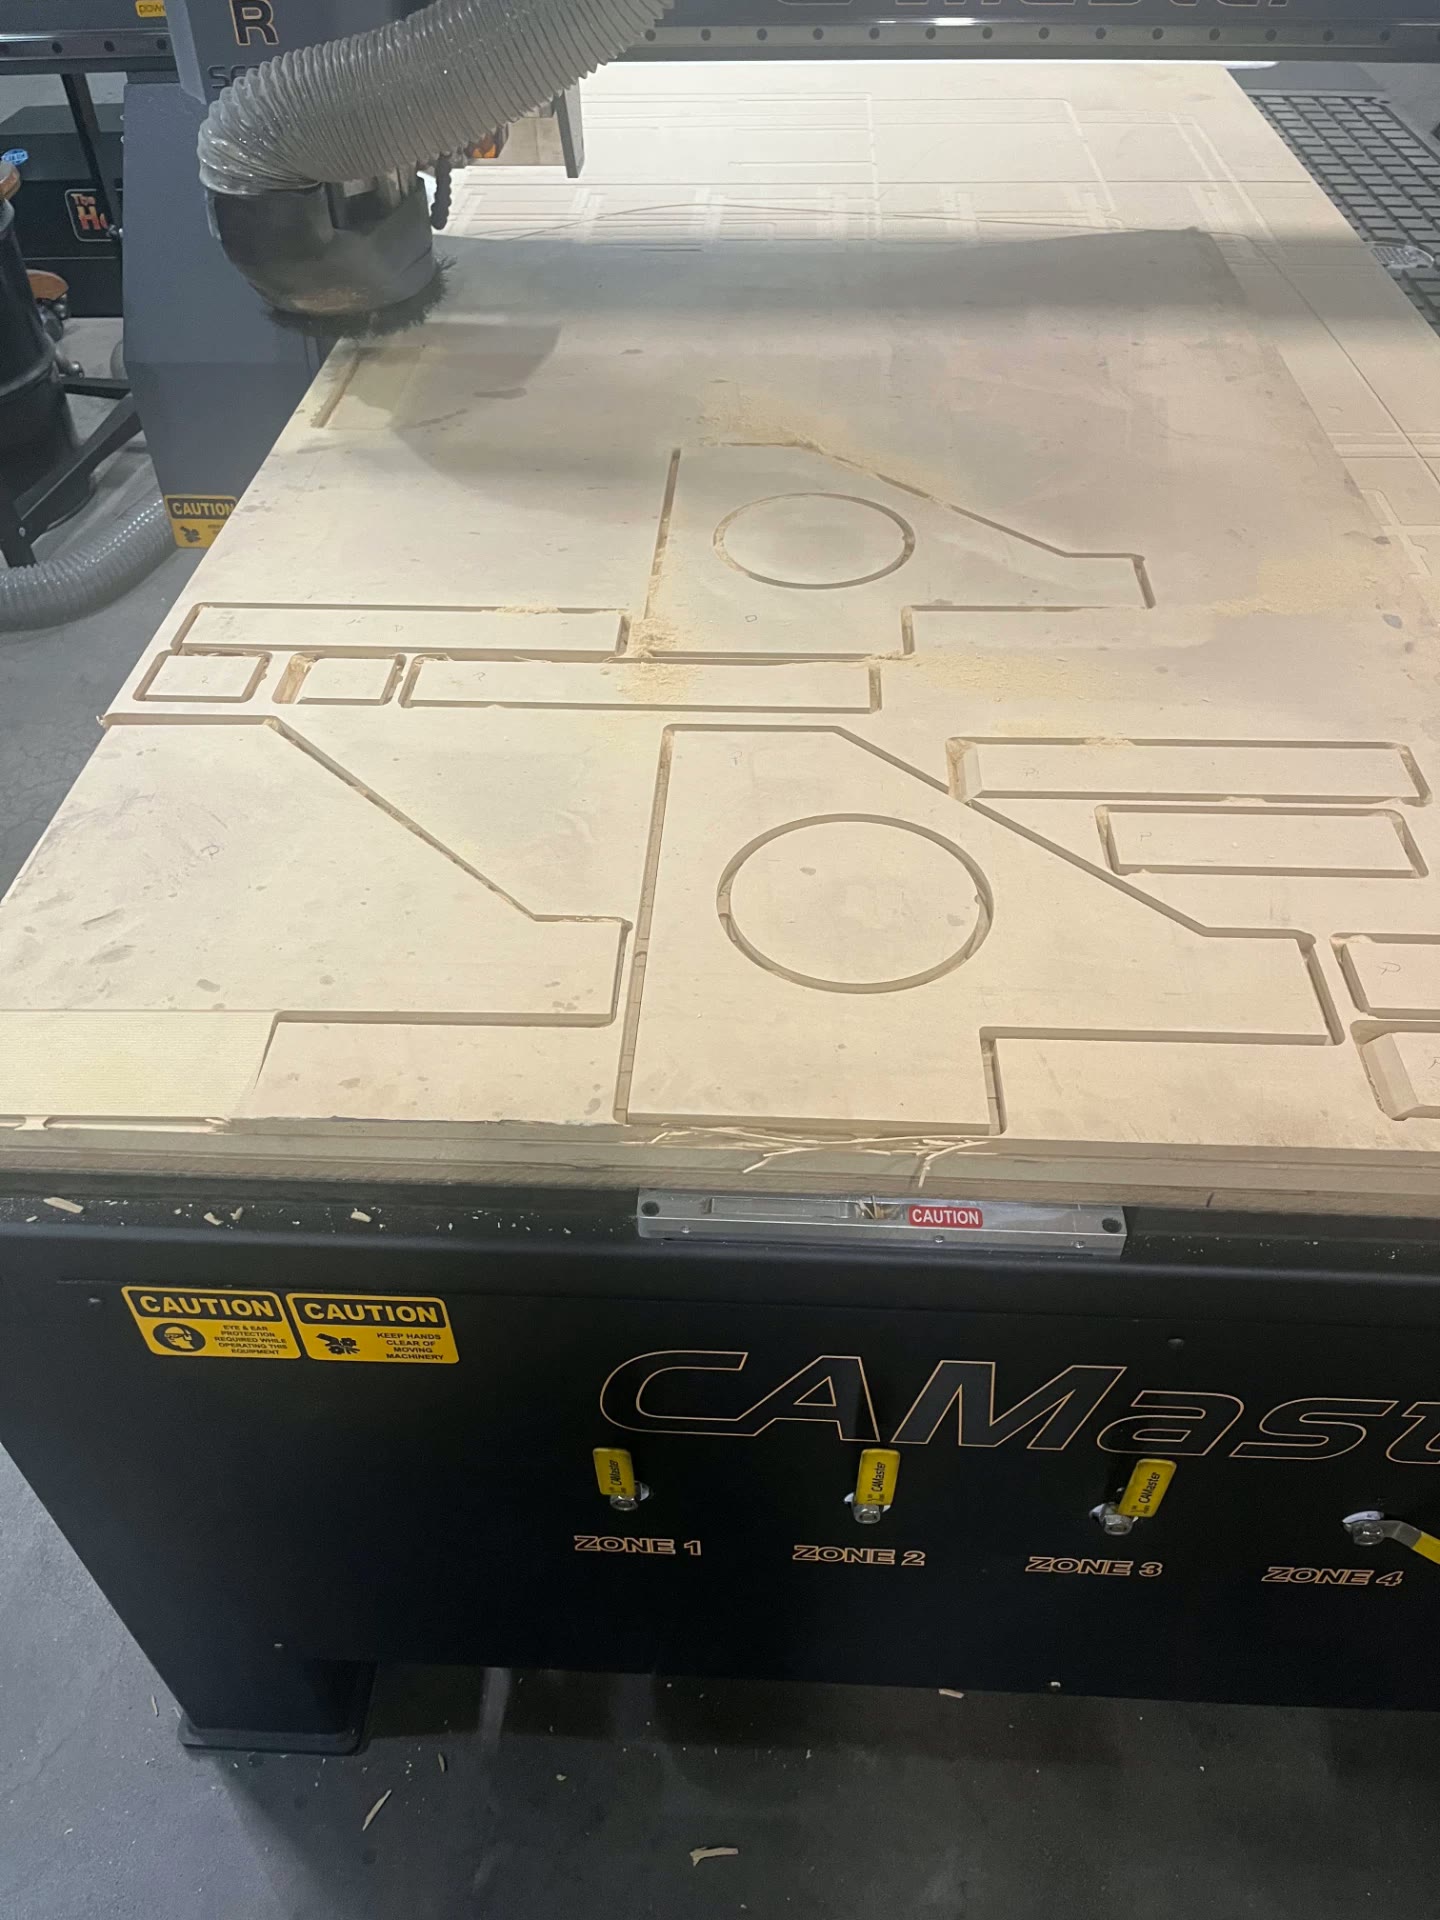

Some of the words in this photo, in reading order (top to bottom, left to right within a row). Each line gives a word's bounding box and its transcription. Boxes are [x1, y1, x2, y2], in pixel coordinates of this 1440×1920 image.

[172, 502, 234, 516] CAUTION
[912, 1208, 979, 1225] CAUTION
[140, 1295, 275, 1317] CAUTION
[304, 1302, 438, 1323] CAUTION
[574, 1535, 675, 1555] ZONE
[684, 1540, 702, 1556] 1
[792, 1545, 896, 1565] ZONE
[901, 1550, 926, 1567] 2
[1025, 1556, 1134, 1577] ZONE
[1138, 1561, 1163, 1578] 3
[1261, 1567, 1375, 1586] ZONE
[1375, 1570, 1404, 1587] 4
